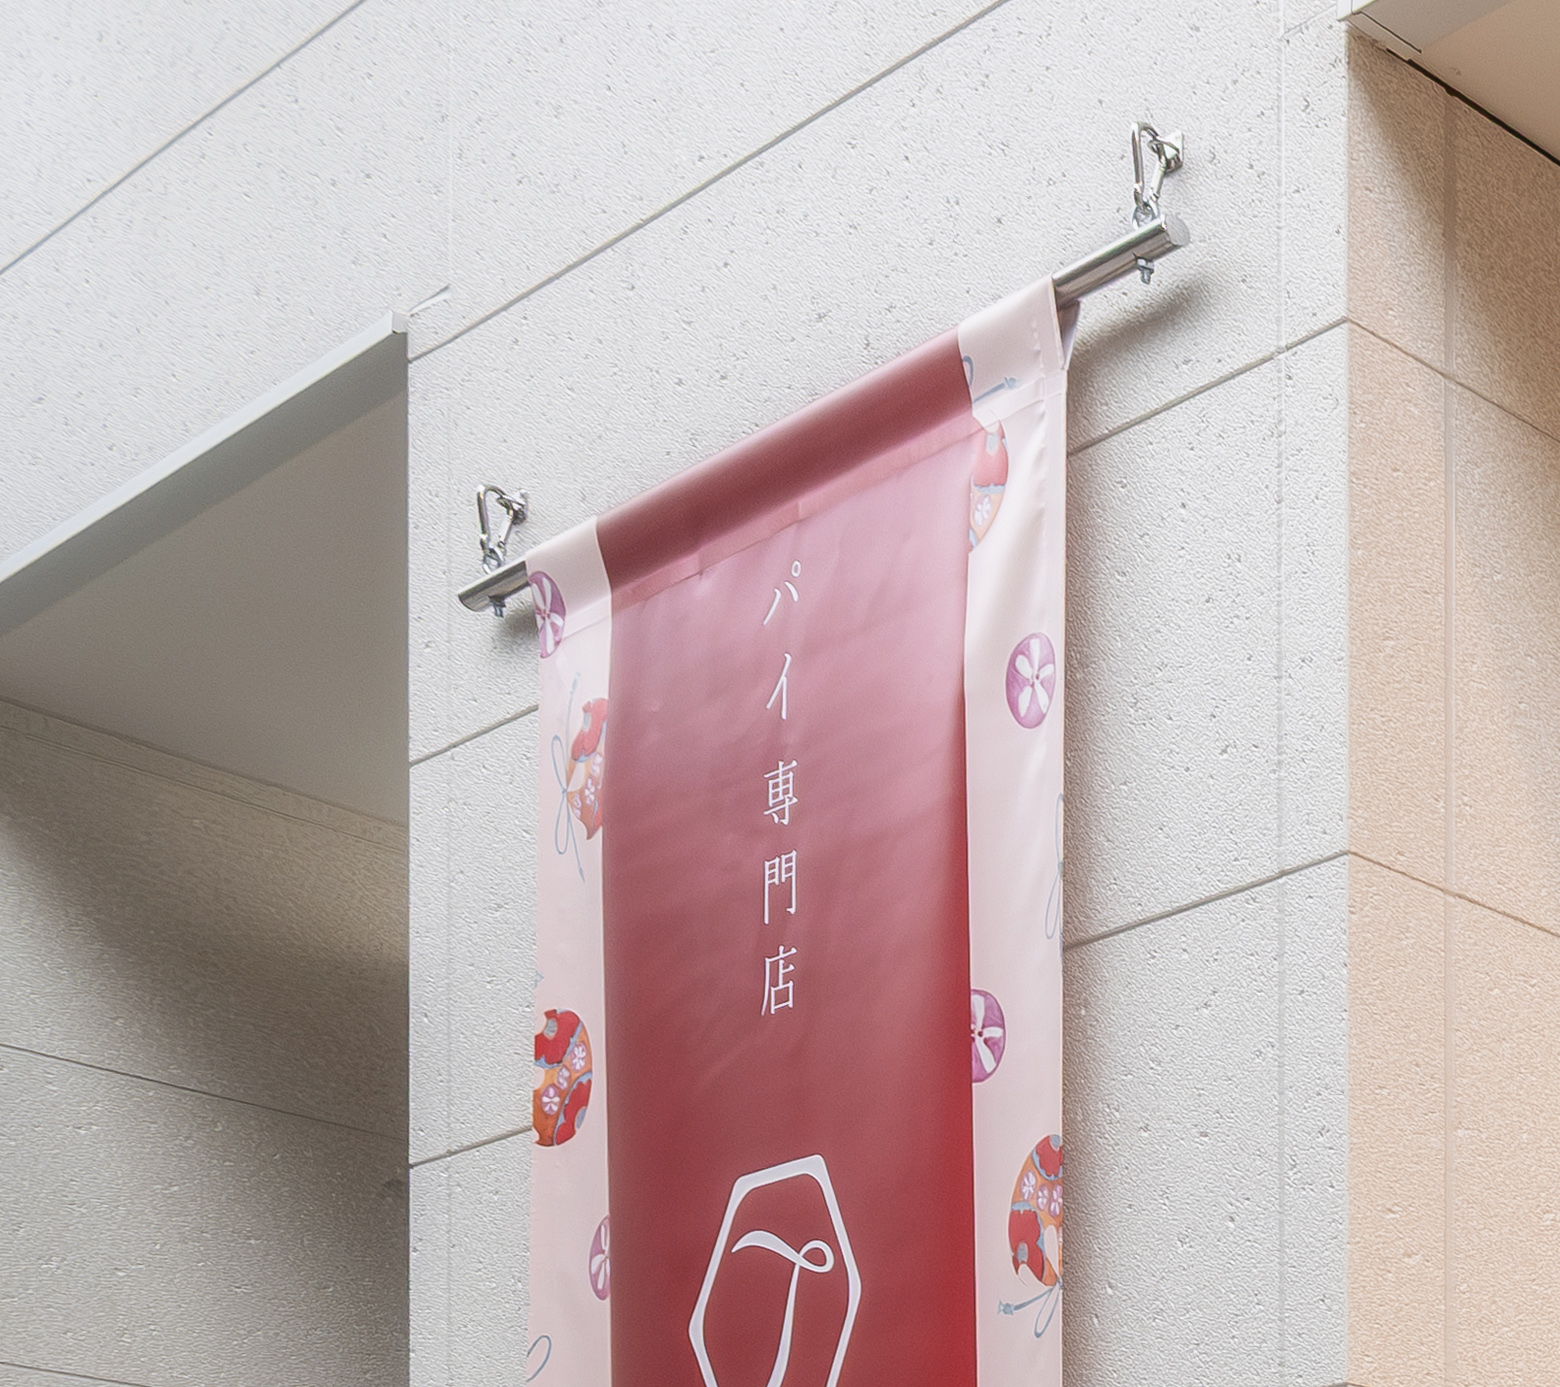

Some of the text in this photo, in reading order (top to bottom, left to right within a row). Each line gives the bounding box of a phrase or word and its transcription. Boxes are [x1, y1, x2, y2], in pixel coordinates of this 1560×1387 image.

[761, 558, 802, 1018] パイ専門店
